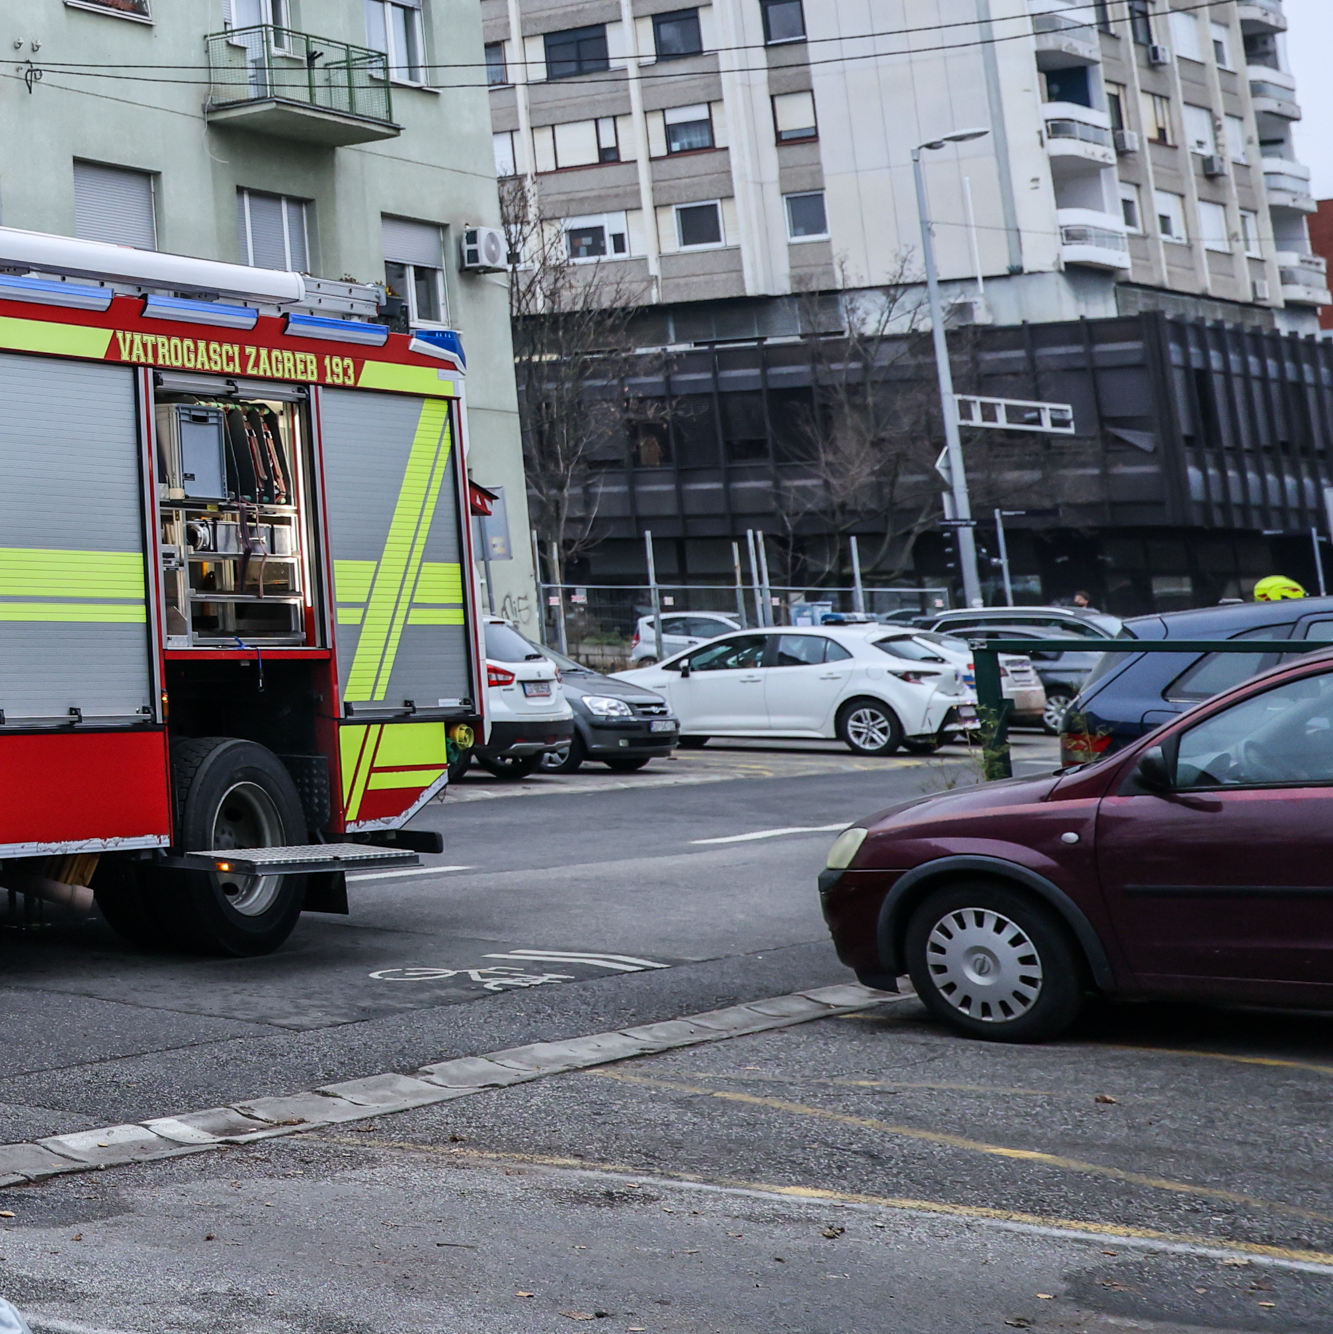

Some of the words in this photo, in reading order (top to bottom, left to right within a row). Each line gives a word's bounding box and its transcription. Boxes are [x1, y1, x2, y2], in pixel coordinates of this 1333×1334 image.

[116, 330, 242, 374] VATROGASCI
[245, 345, 318, 382] ZAGREB
[324, 355, 355, 386] 193
